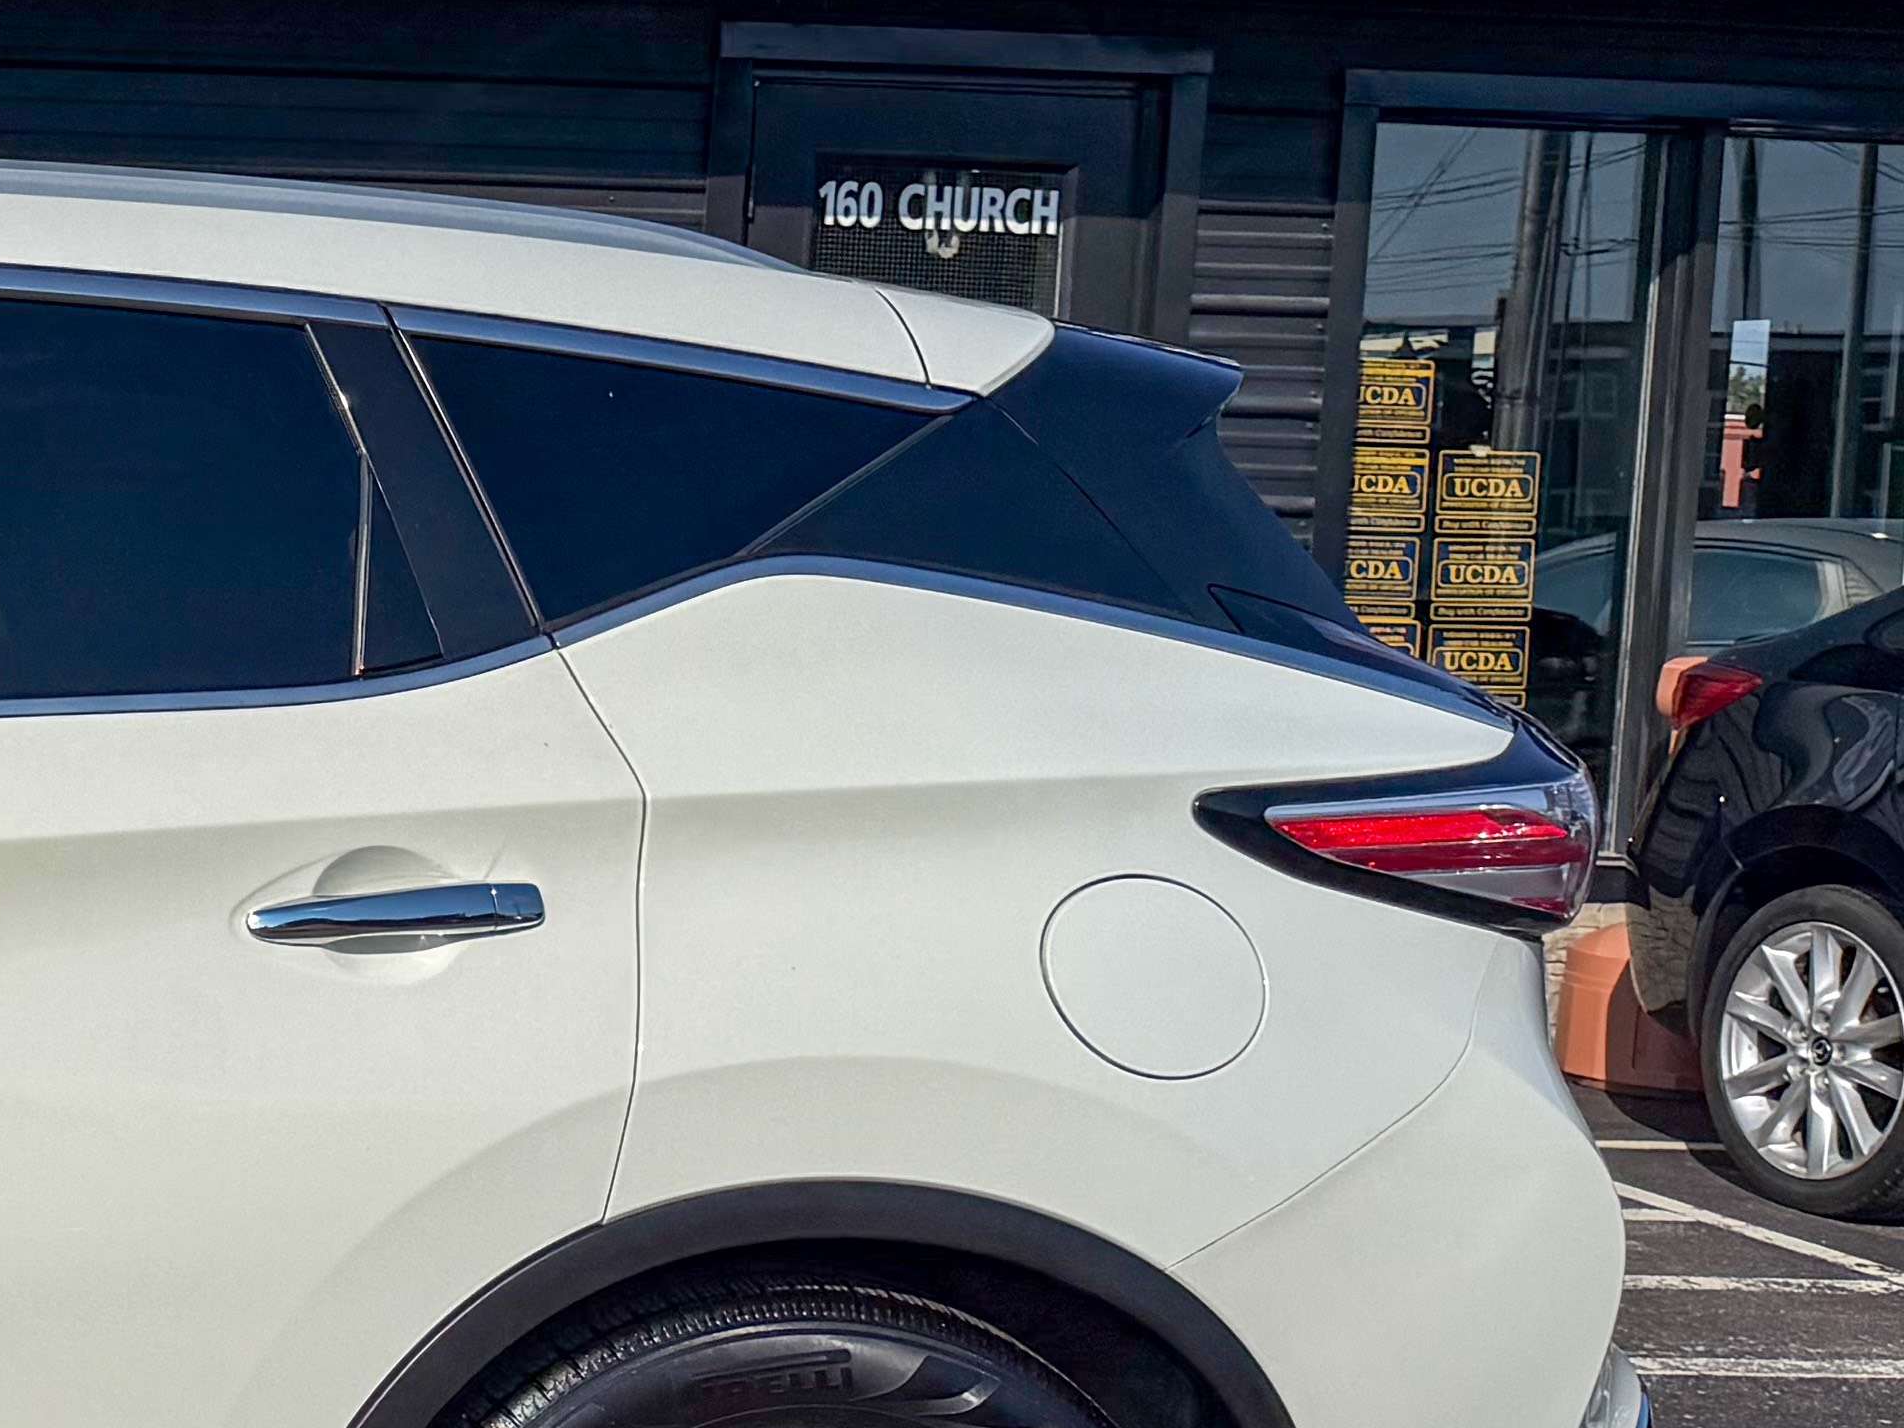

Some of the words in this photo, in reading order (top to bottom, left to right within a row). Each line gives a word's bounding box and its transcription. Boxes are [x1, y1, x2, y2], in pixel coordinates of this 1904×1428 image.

[818, 180, 884, 229] 160
[898, 182, 1060, 236] CHURCH
[1453, 478, 1524, 497] UCDA
[1345, 560, 1403, 579] CDA
[1448, 565, 1520, 584] UCDA
[1443, 651, 1513, 671] UCDA
